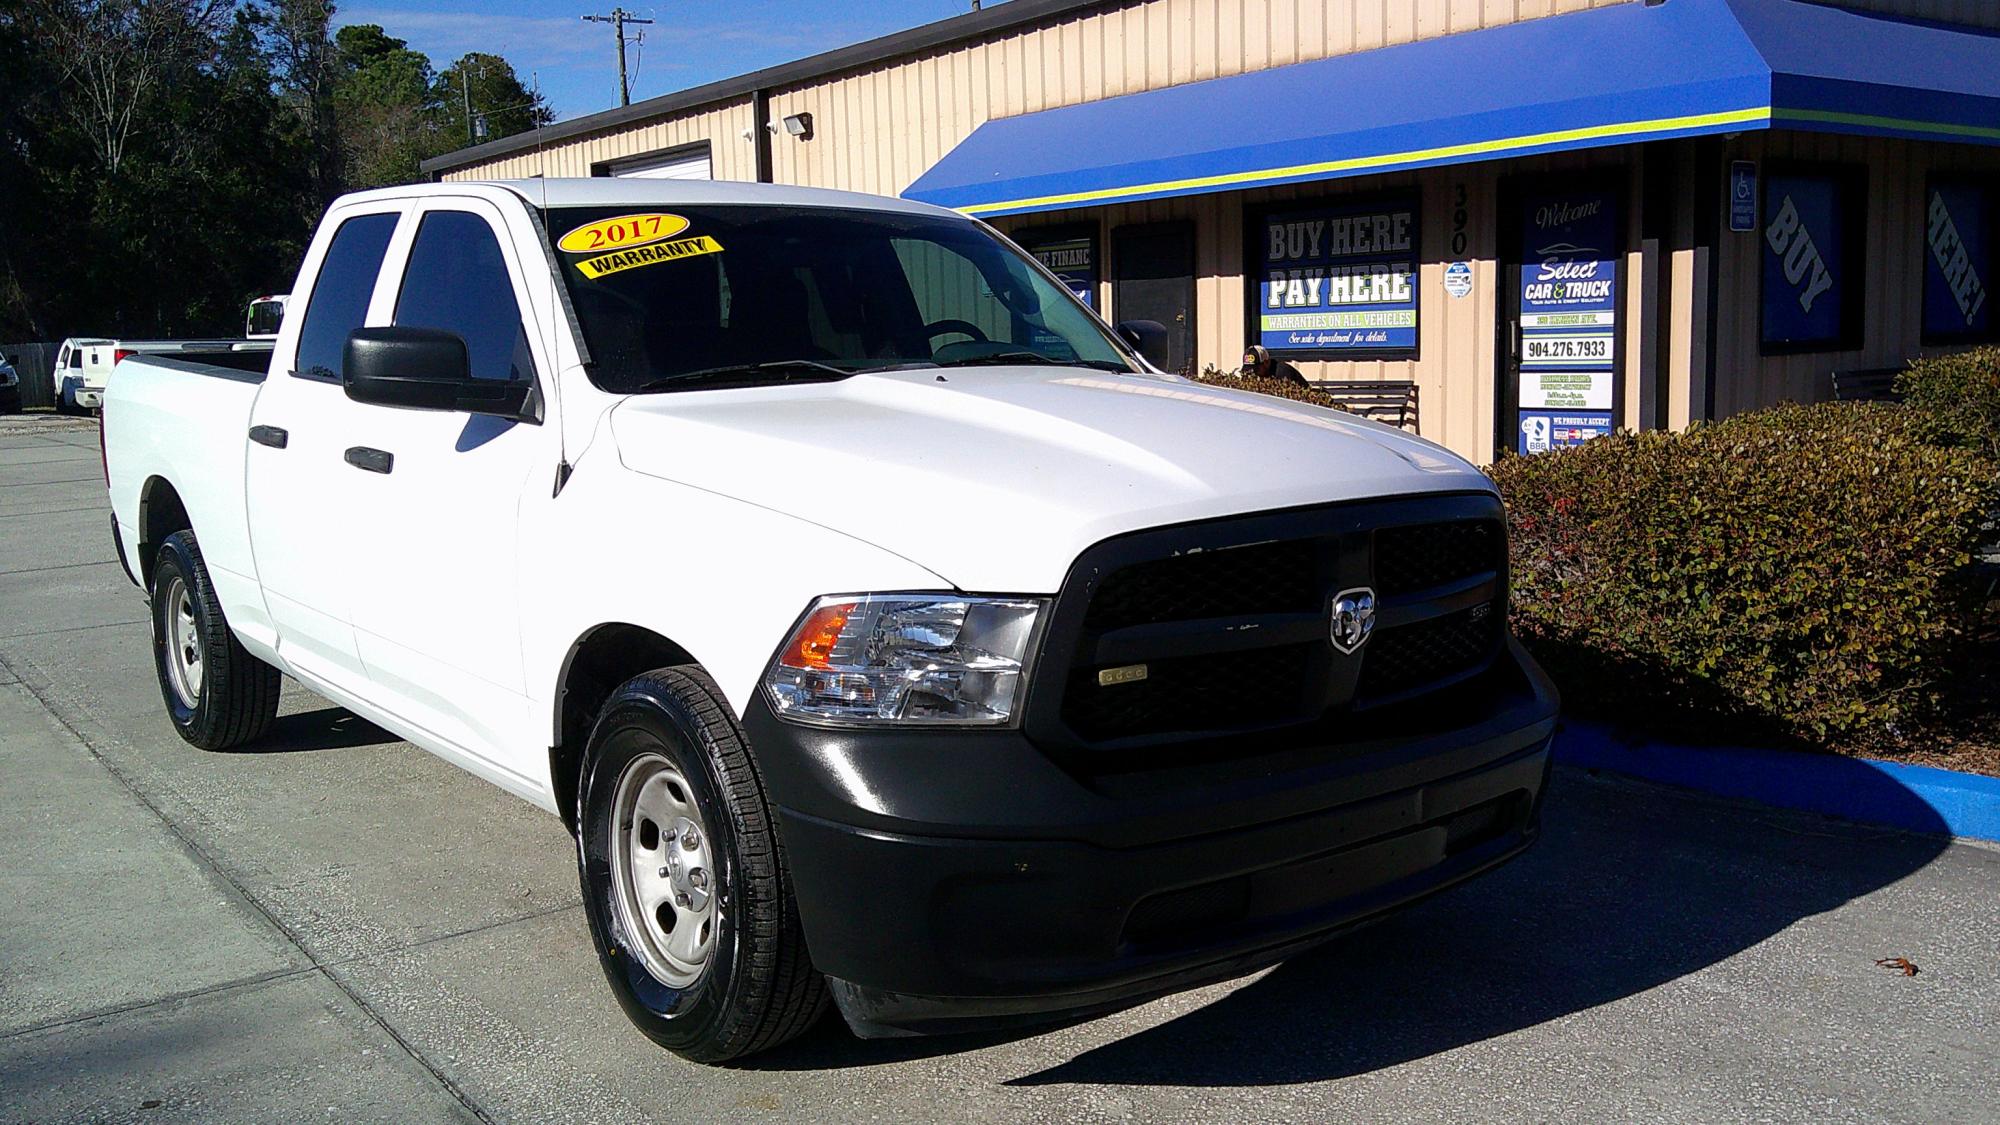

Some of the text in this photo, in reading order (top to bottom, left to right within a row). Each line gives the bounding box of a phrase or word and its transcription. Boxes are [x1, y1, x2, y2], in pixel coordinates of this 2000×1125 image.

[1452, 184, 1468, 255] 390
[1535, 199, 1601, 229] Welcome
[586, 216, 662, 249] 2017
[1268, 212, 1412, 260] BUY HERE
[589, 238, 709, 274] WARRANTY
[1537, 256, 1598, 281] Select
[1766, 194, 1833, 314] BUY
[1928, 191, 1986, 325] HERE!
[1268, 263, 1412, 309] PAY HERE
[1525, 281, 1611, 299] CAR & TRUCK
[1268, 312, 1411, 329] WARRANTIES ON ALL VEHICLES
[1288, 332, 1300, 343] See
[1316, 331, 1352, 346] department
[1350, 331, 1364, 346] for
[1529, 341, 1605, 358] 904.276.7933
